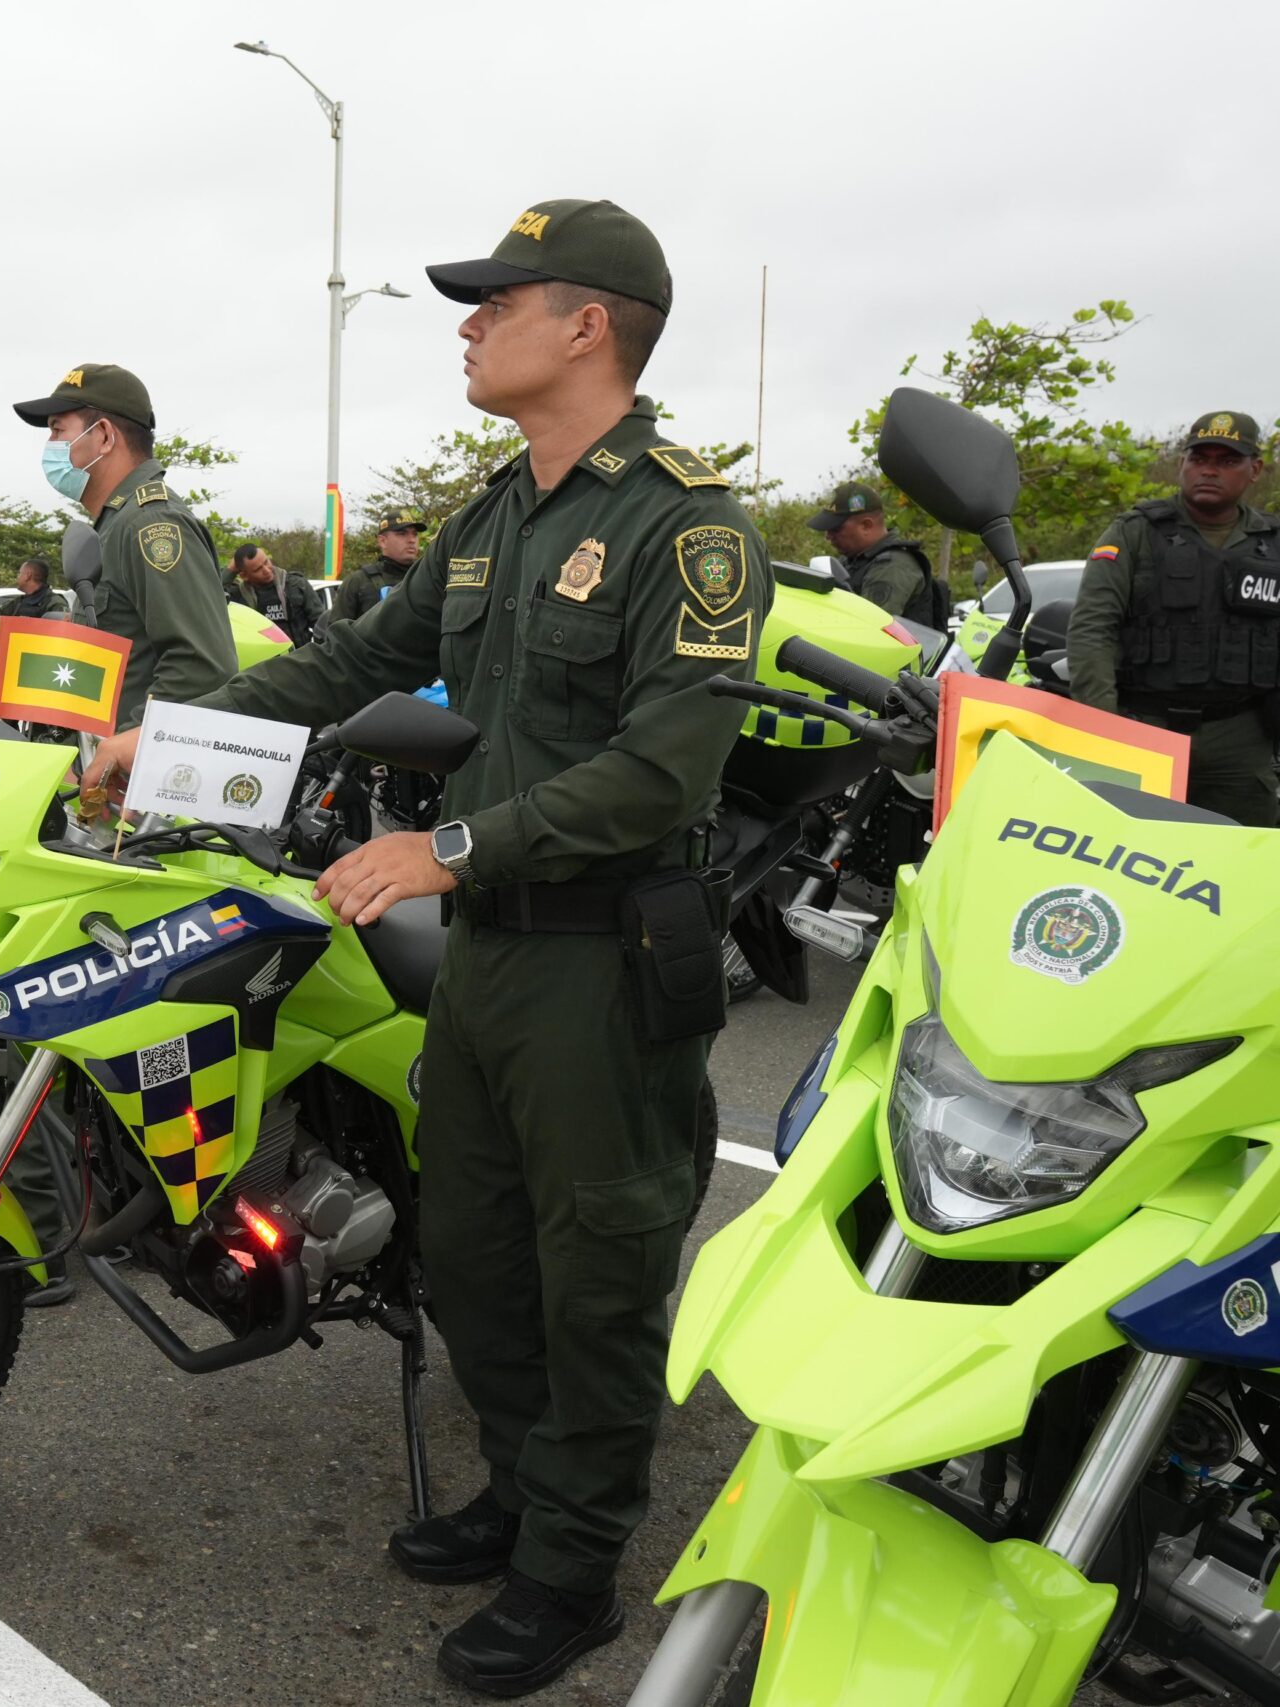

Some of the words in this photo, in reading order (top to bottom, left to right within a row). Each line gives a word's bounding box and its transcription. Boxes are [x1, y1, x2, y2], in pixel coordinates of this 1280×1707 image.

[684, 538, 739, 557] NACIONAL
[166, 733, 200, 747] ALCALDÍA
[201, 739, 212, 749] DE
[213, 740, 292, 763] BARRANQUILLA
[997, 817, 1221, 917] POLICÍA
[14, 918, 213, 1010] POLICÍA
[1044, 964, 1073, 974] PATRIA
[1049, 953, 1091, 965] NACIONAL
[247, 980, 293, 1005] HONDA
